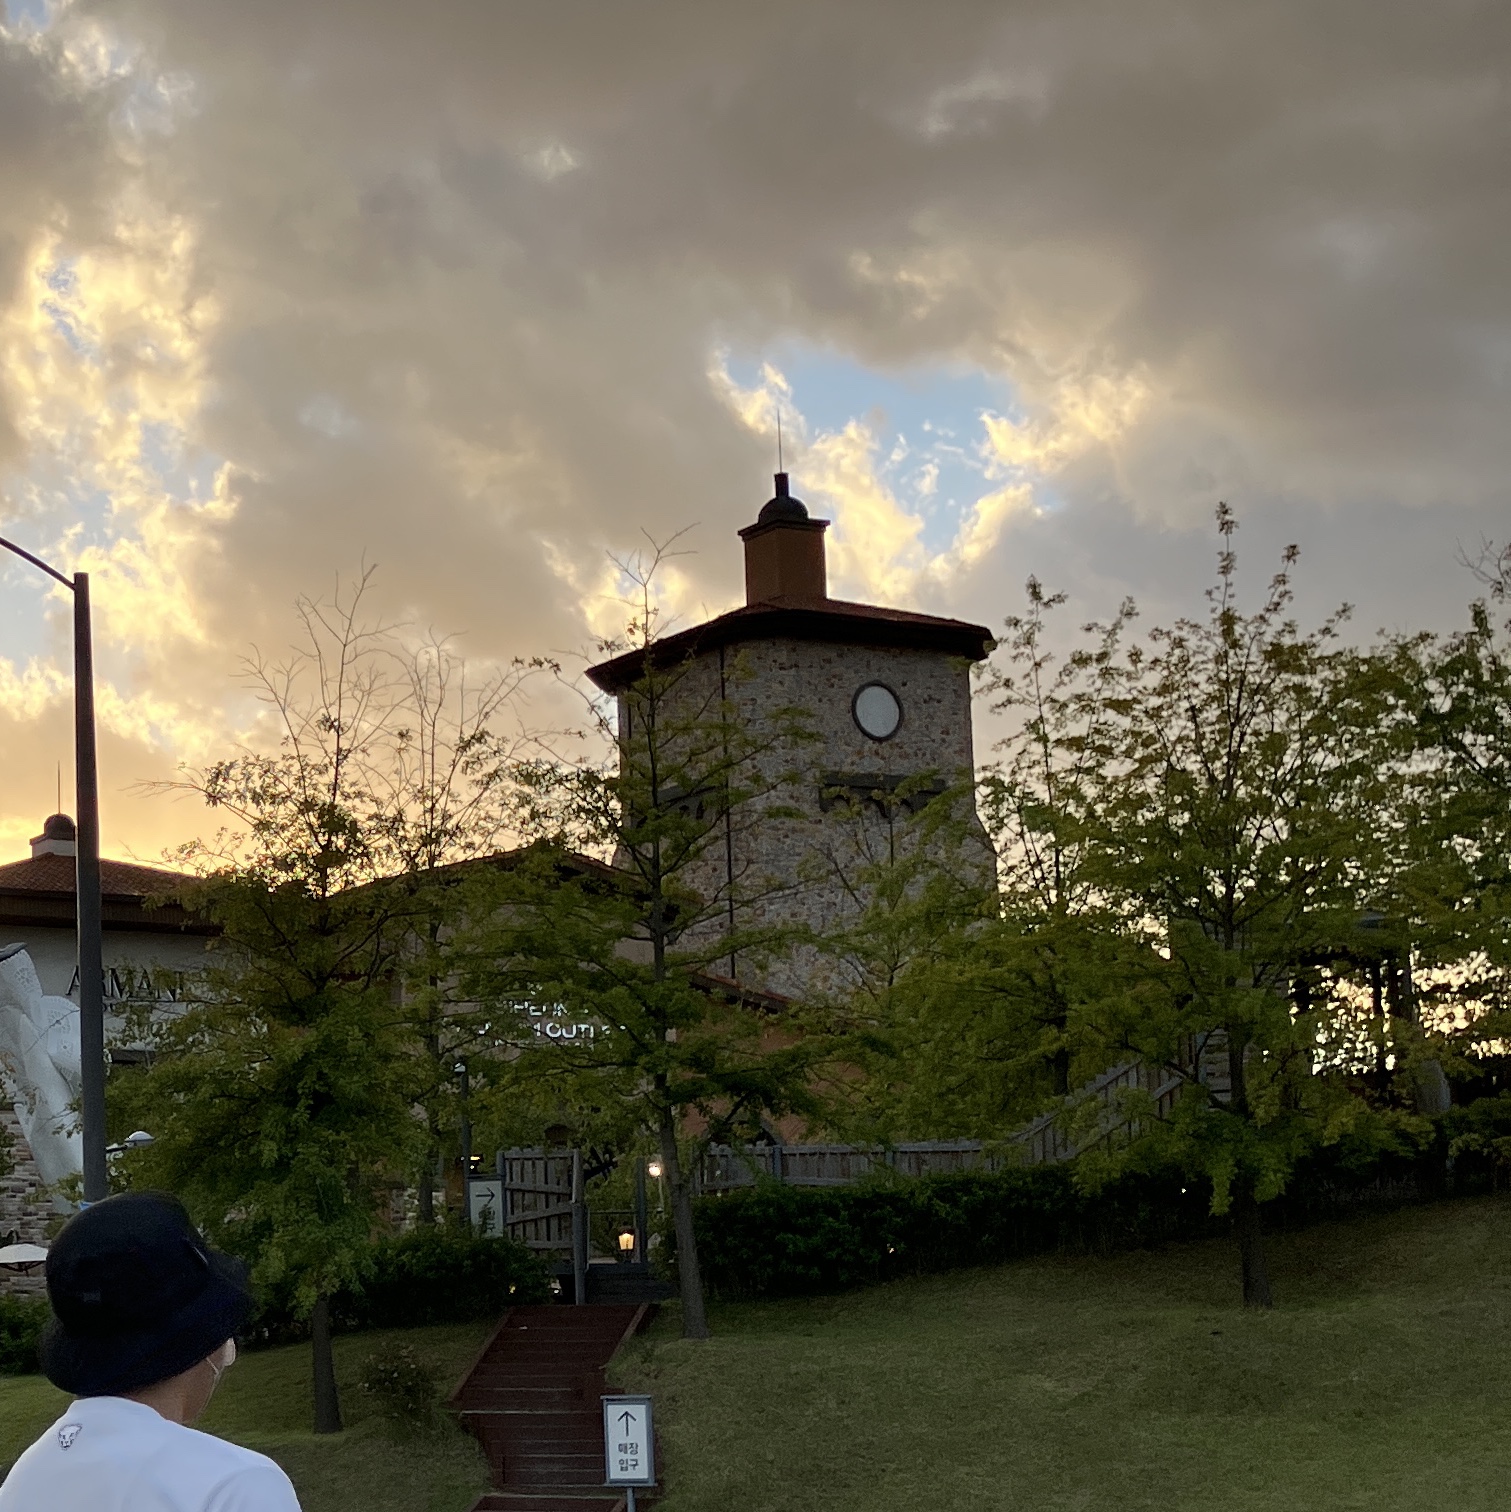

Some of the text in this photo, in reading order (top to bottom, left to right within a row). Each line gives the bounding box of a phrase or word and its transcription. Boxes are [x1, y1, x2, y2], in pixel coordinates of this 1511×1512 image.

[65, 965, 185, 1000] AMANI
[617, 1442, 639, 1455] 매장
[618, 1458, 639, 1471] 입구
